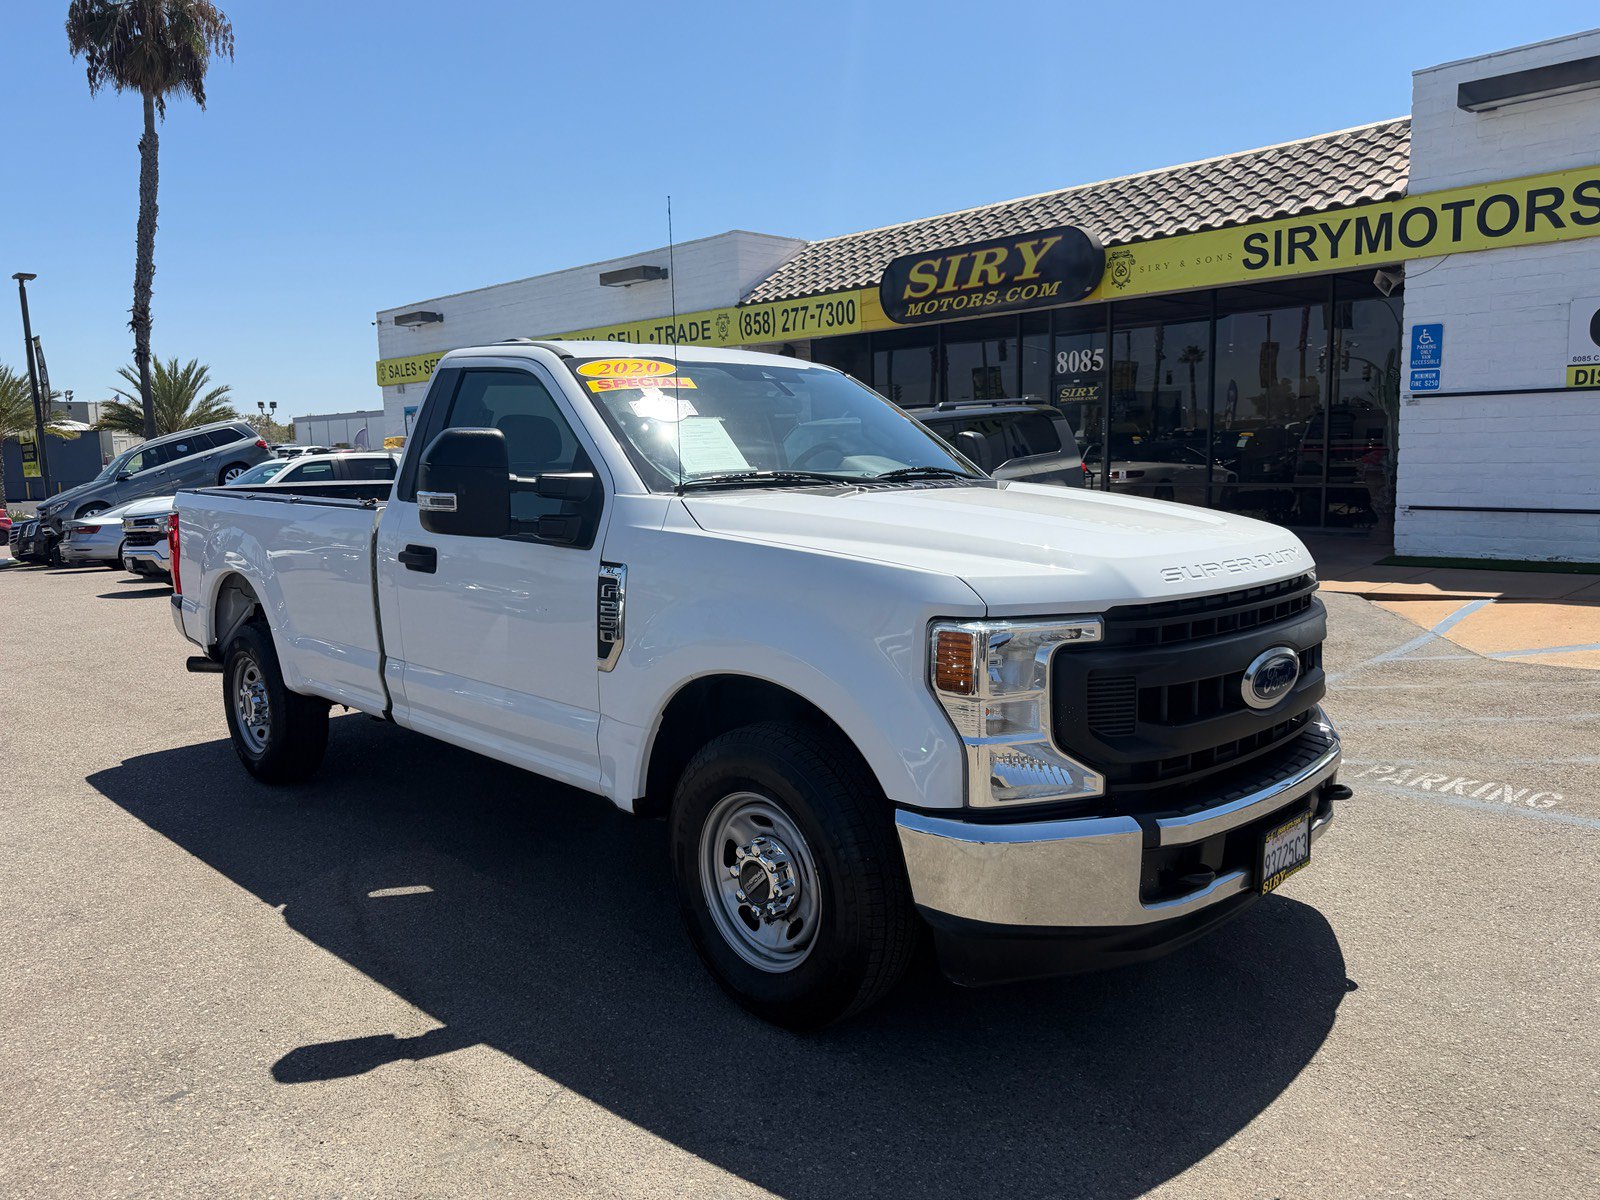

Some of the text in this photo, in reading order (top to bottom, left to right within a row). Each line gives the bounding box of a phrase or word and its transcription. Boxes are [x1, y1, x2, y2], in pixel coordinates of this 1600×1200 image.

[903, 235, 1064, 299] SIRY
[1139, 252, 1233, 274] SIRY & SONS
[905, 281, 1063, 317] MOTORS.COM
[654, 319, 711, 345] TRADE
[739, 306, 776, 340] (858)
[781, 299, 856, 333] 277-7300
[388, 362, 417, 379] SALES
[598, 362, 660, 376] 2020
[1056, 348, 1104, 374] 8085
[1411, 358, 1440, 366] ACCESSIBLE
[1572, 355, 1592, 363] 8085
[597, 377, 689, 390] SPECIAL
[1060, 386, 1099, 398] SIRY
[1160, 556, 1257, 584] SUPER
[1353, 764, 1564, 809] PARKING
[1261, 869, 1288, 896] SIRY
